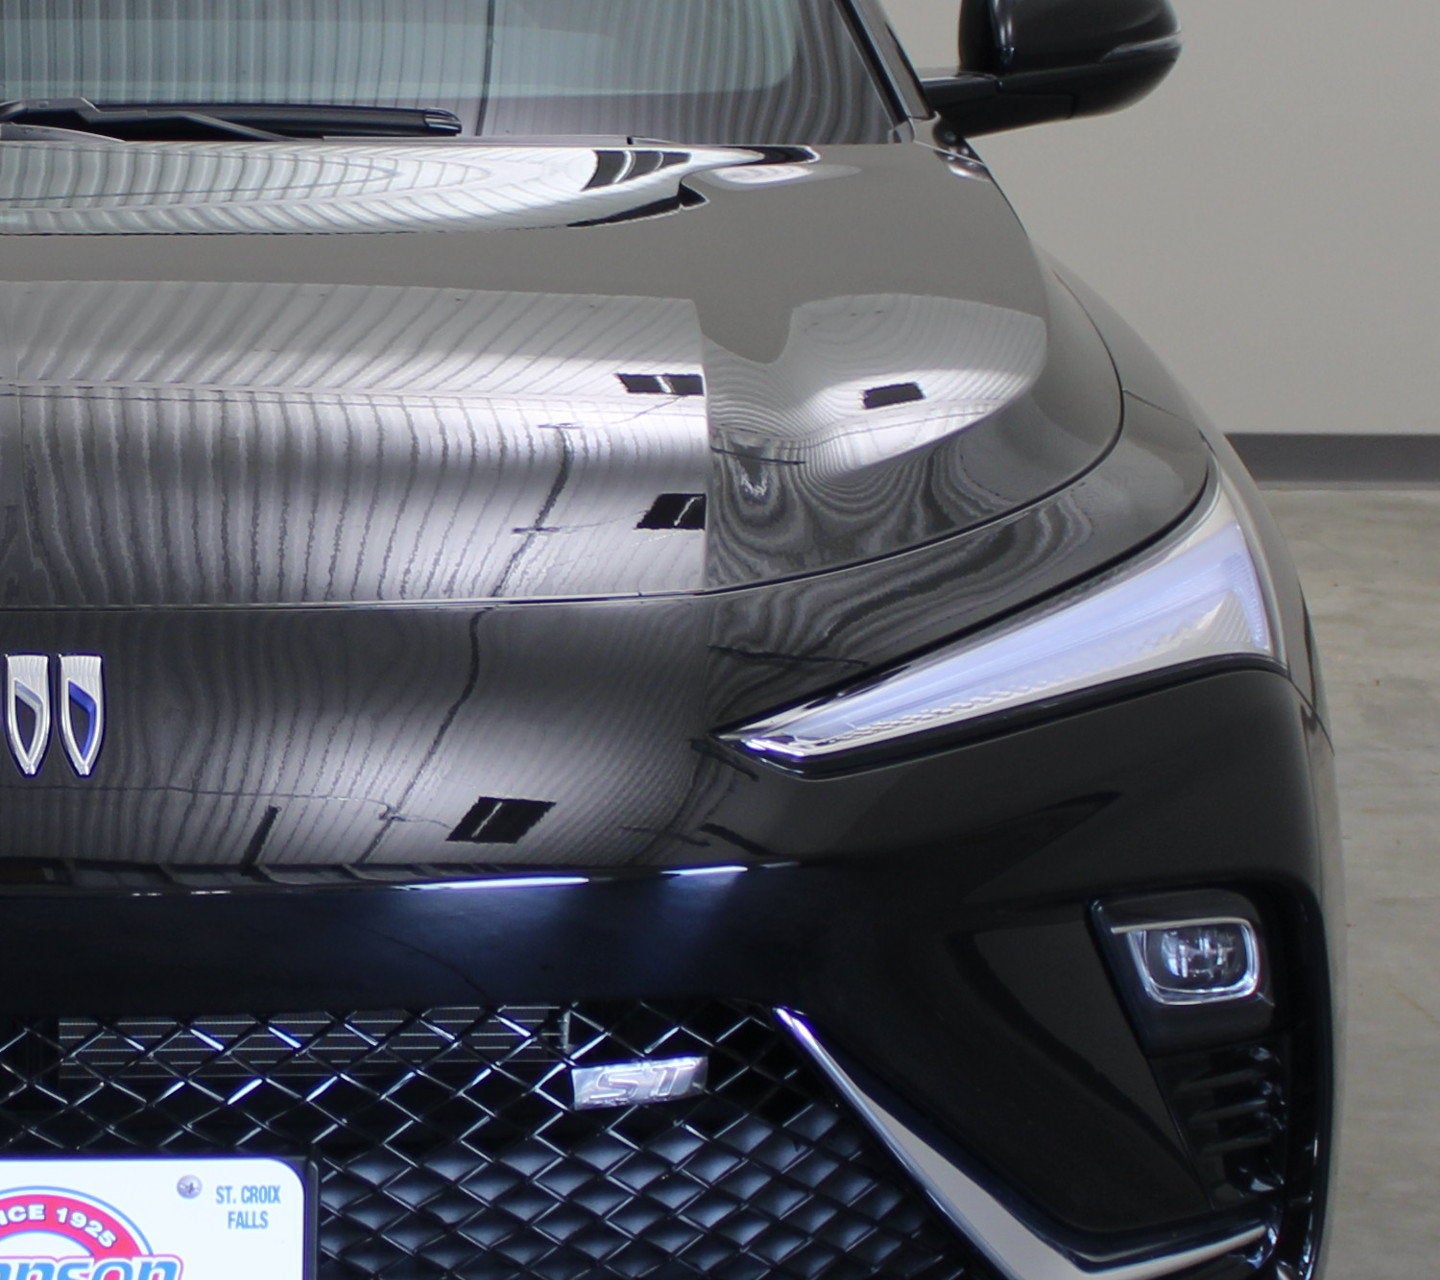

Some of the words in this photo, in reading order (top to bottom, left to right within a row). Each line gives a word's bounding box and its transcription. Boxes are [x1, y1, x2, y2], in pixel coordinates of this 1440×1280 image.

[588, 1062, 697, 1101] ST
[215, 1185, 237, 1205] ST.
[241, 1184, 282, 1204] CROIX
[56, 1207, 118, 1248] 1925
[226, 1210, 269, 1230] FALLS
